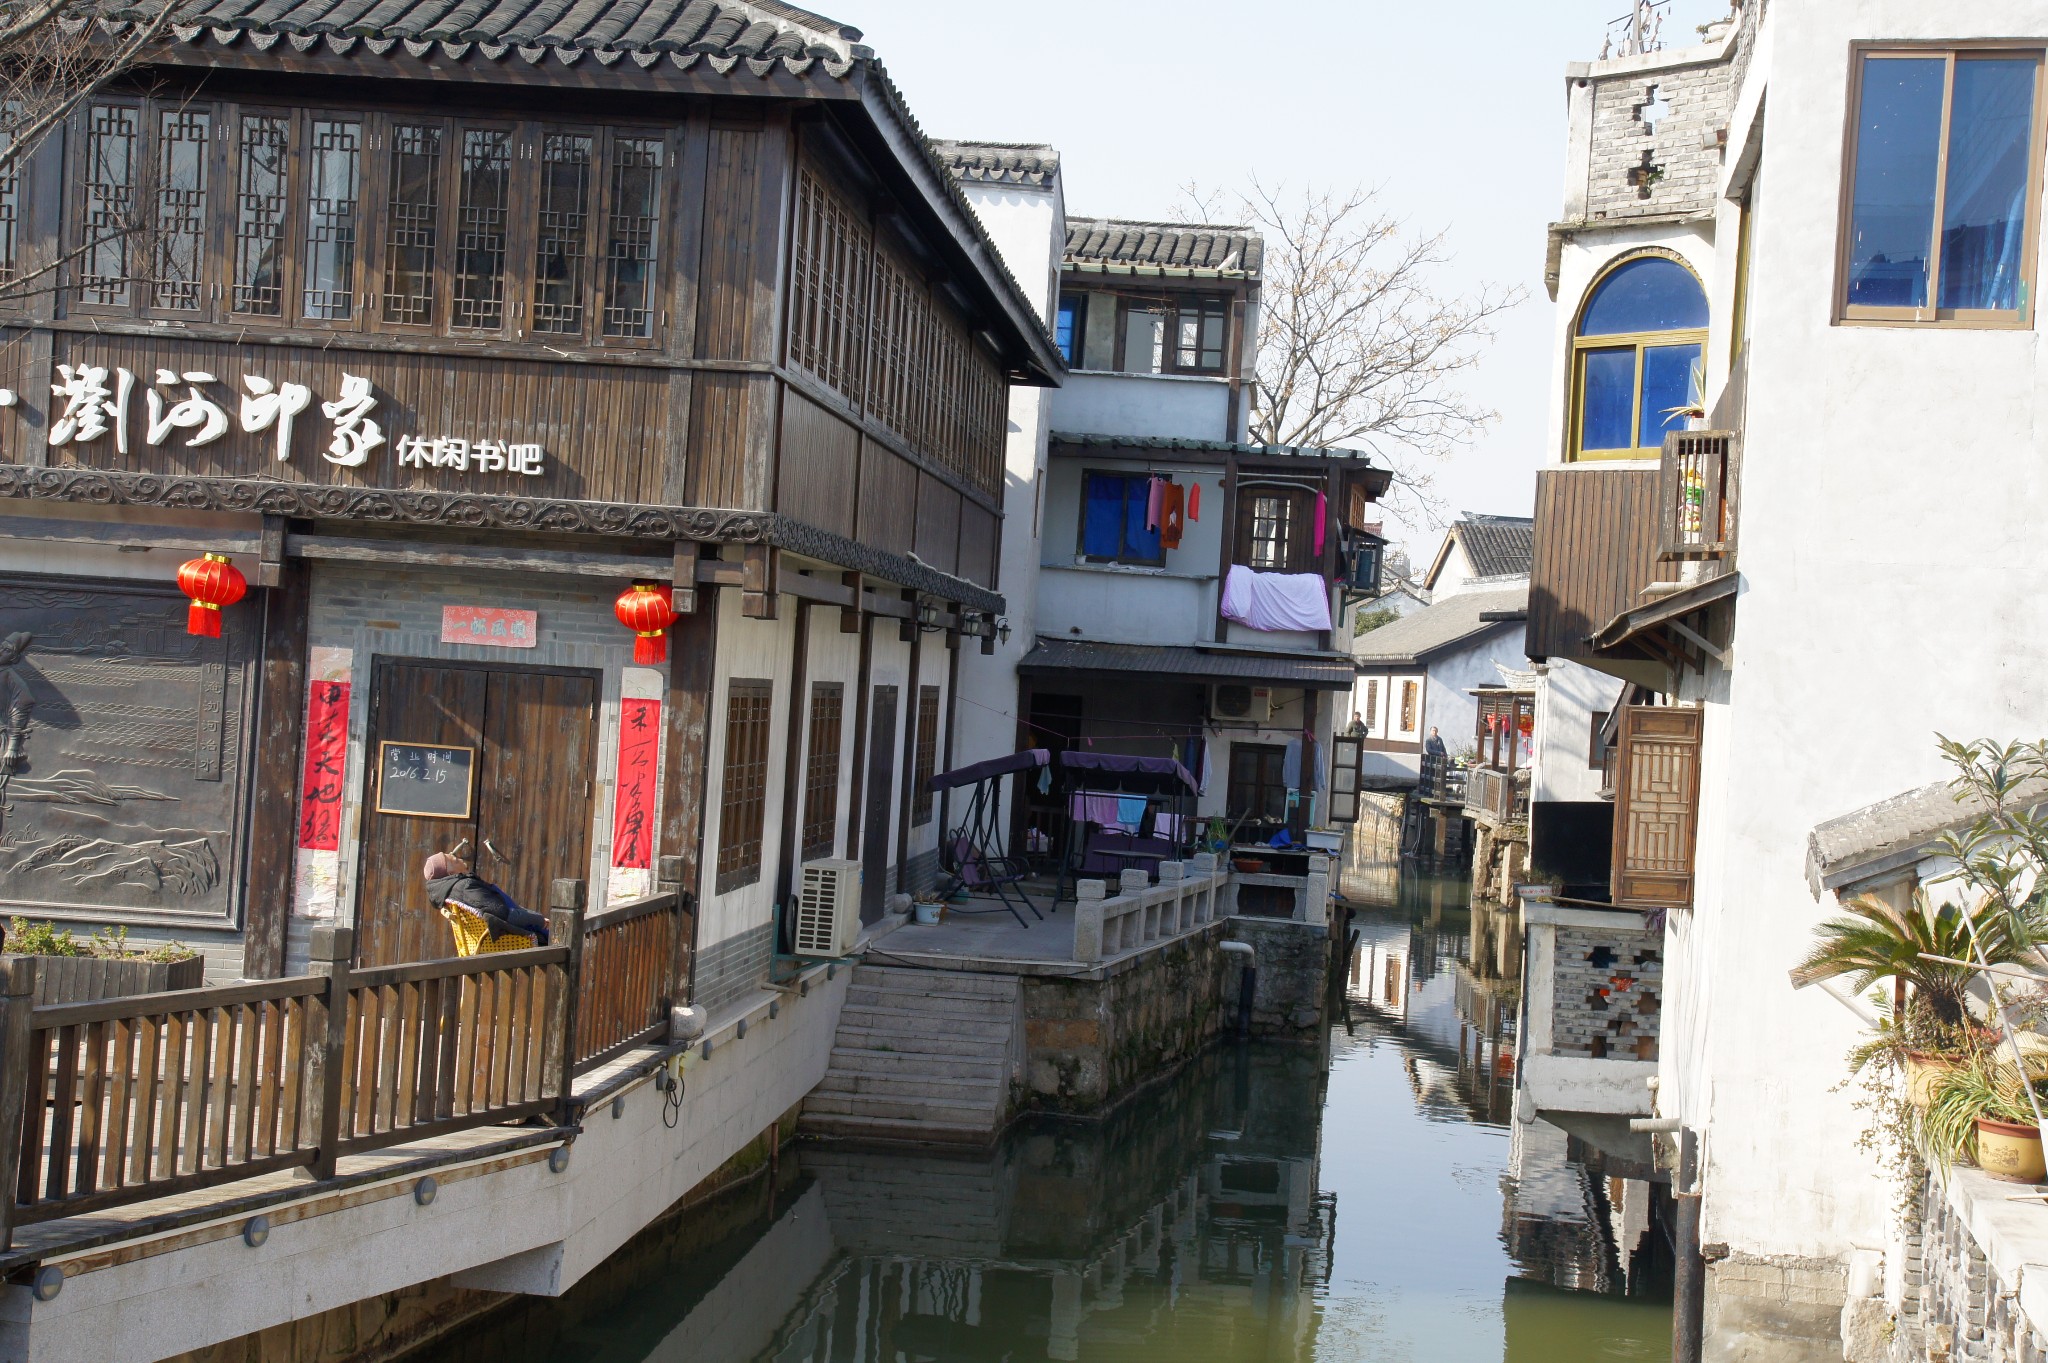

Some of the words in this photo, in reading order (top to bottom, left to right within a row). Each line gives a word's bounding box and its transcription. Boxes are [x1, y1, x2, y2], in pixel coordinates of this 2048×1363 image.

[396, 434, 545, 475] 休闲书吧
[390, 748, 452, 764] 营业时间
